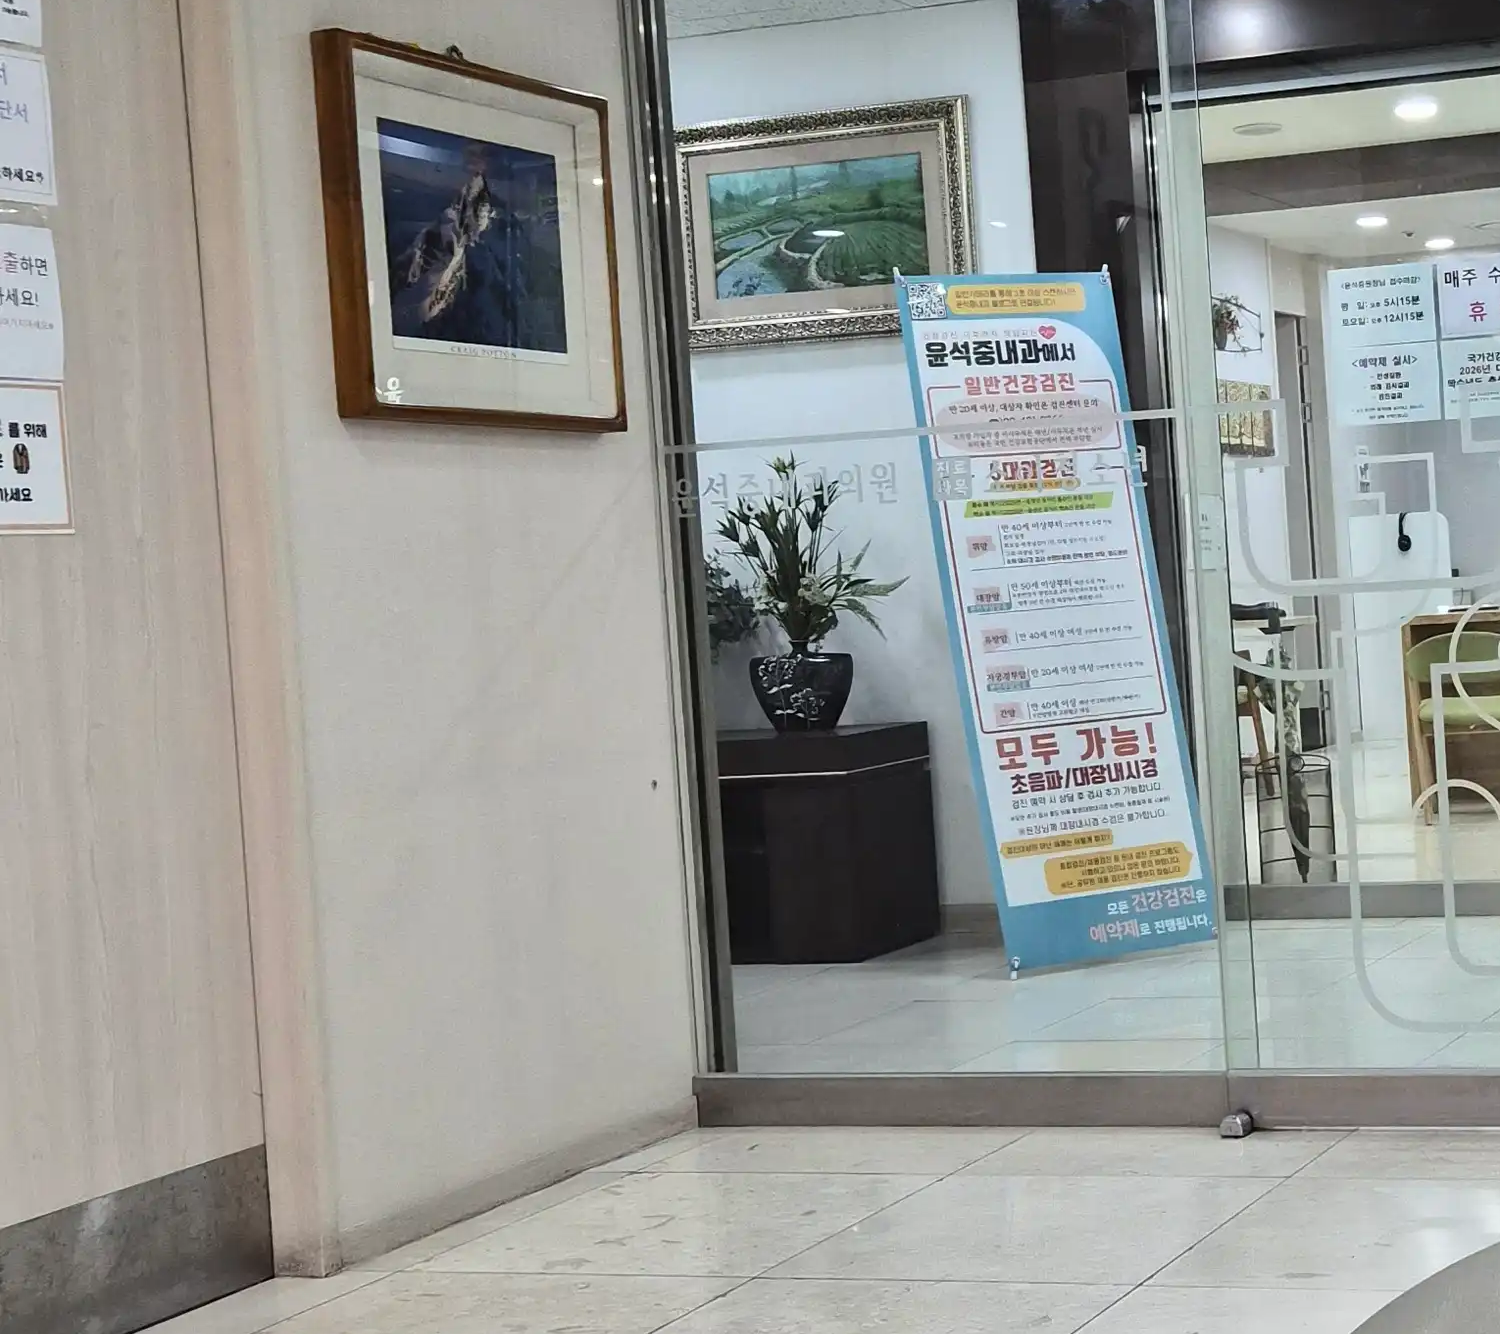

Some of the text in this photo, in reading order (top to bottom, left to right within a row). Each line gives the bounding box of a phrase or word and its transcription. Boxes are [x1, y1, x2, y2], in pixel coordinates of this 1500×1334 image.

[1444, 268, 1478, 289] 매주
[925, 339, 1076, 367] 윤석중내과에서
[1459, 364, 1491, 376] 2026년
[964, 372, 1076, 396] 일반건강검진
[996, 722, 1157, 771] 모두 가능!
[1010, 758, 1158, 795] 초음파/대장내시경
[1107, 886, 1208, 916] 모든 건강검진은
[1089, 919, 1152, 943] 예약제로
